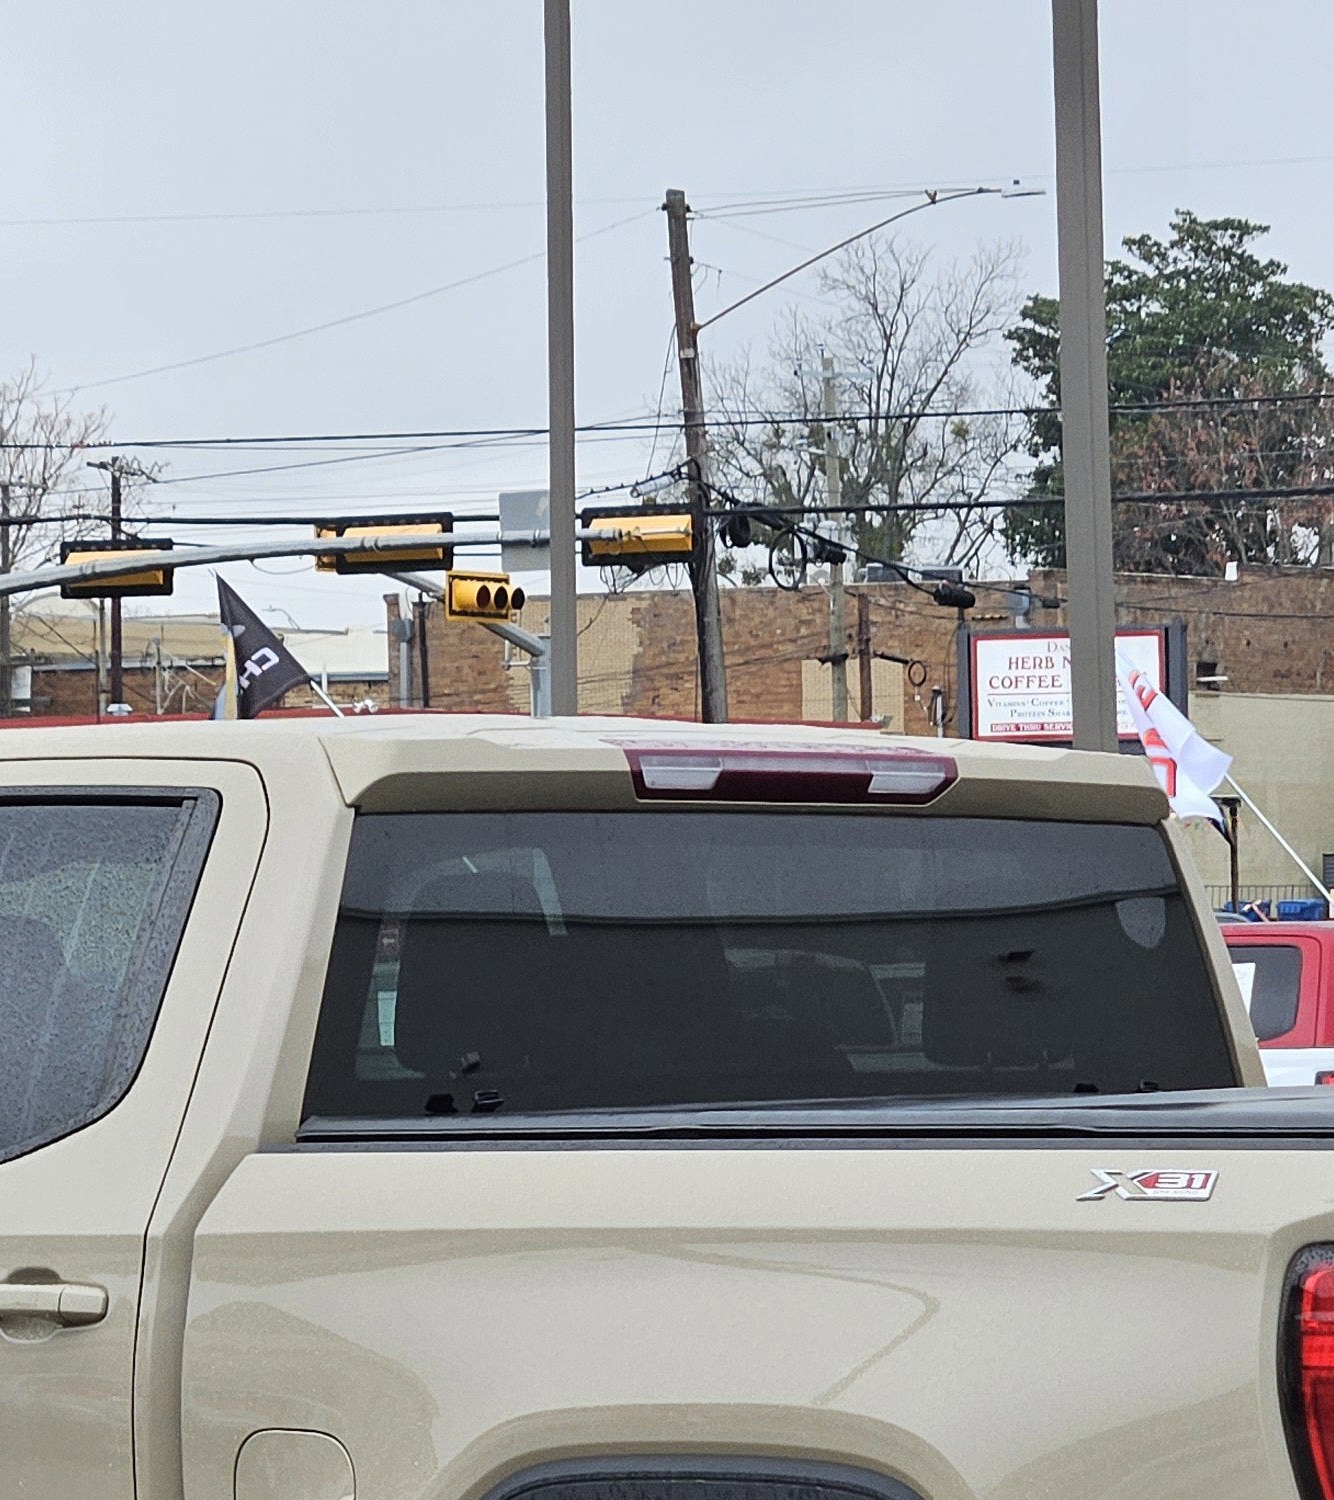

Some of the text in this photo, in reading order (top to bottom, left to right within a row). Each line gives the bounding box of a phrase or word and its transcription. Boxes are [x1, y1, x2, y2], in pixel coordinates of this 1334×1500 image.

[1008, 656, 1055, 670] HERB
[988, 674, 1063, 689] COFFEE
[1076, 1168, 1219, 1201] X31
